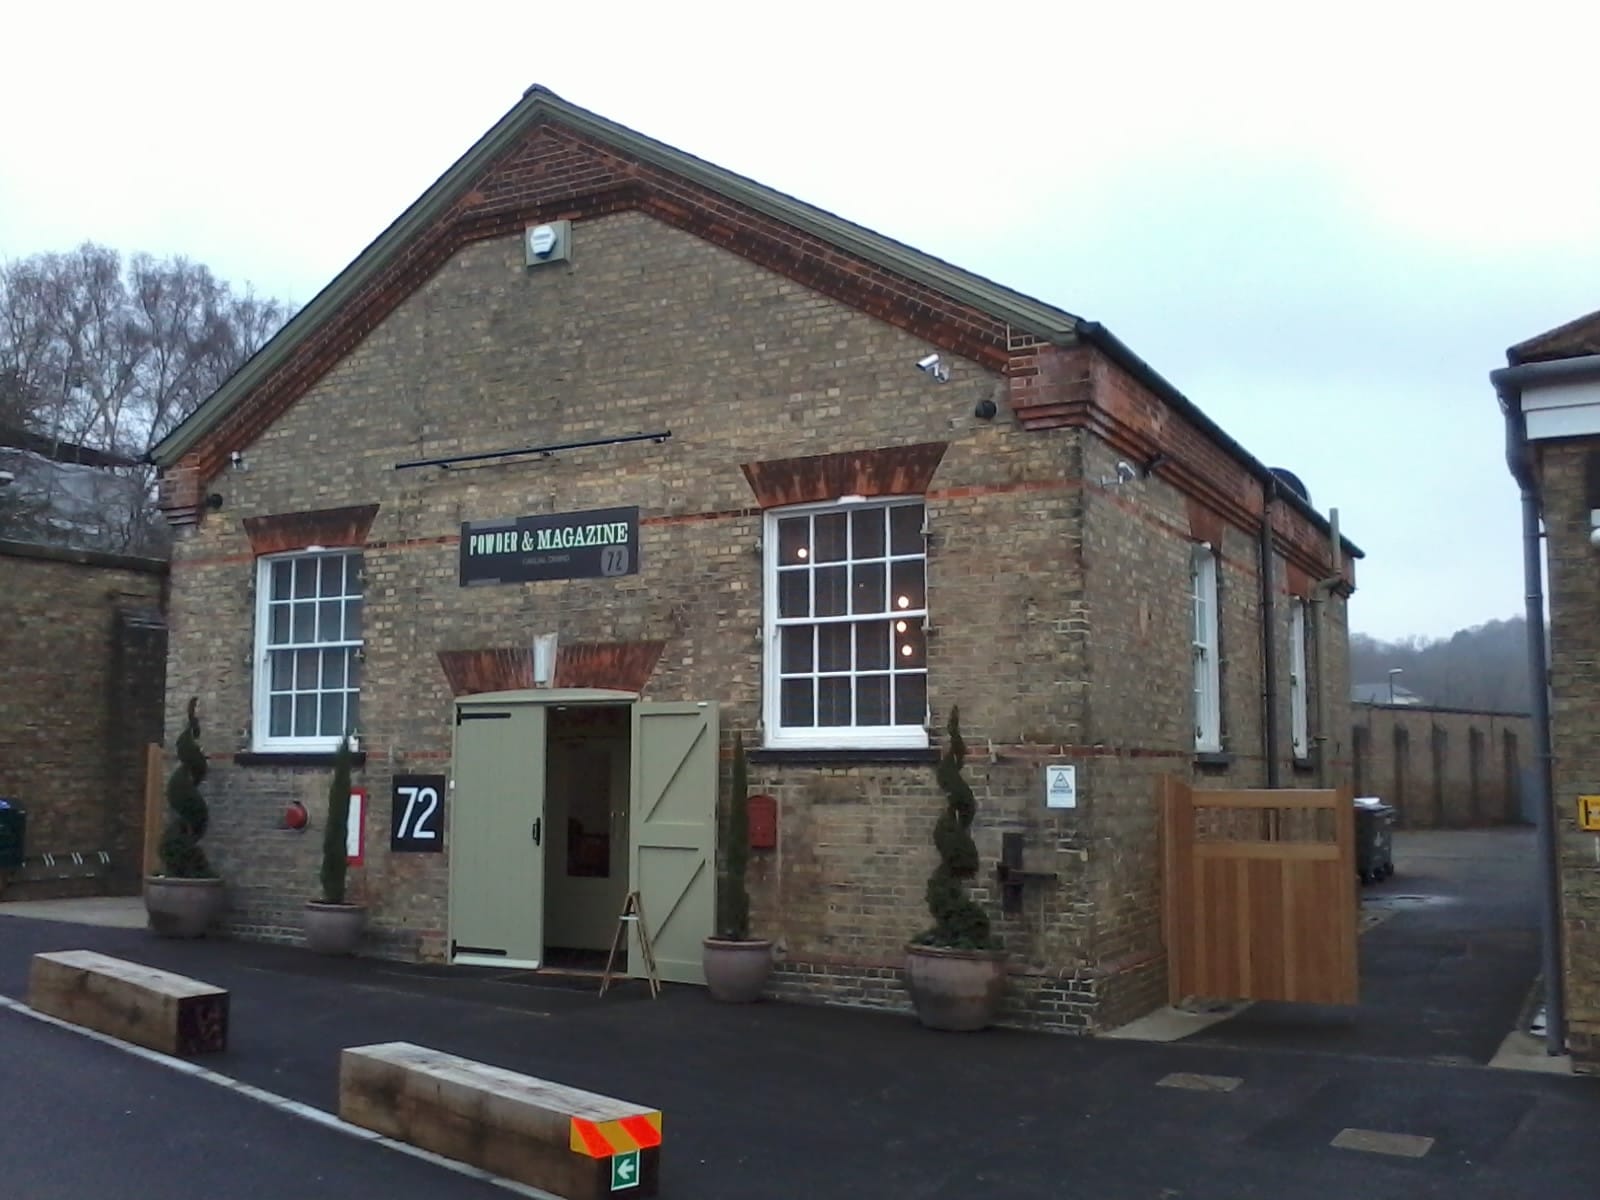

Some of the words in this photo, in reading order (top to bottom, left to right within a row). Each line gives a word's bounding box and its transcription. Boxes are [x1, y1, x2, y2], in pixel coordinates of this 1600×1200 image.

[470, 531, 518, 556] POWDER
[521, 531, 534, 552] &
[537, 522, 629, 550] MAGAZINE
[607, 550, 624, 572] 72
[397, 787, 438, 838] 72
